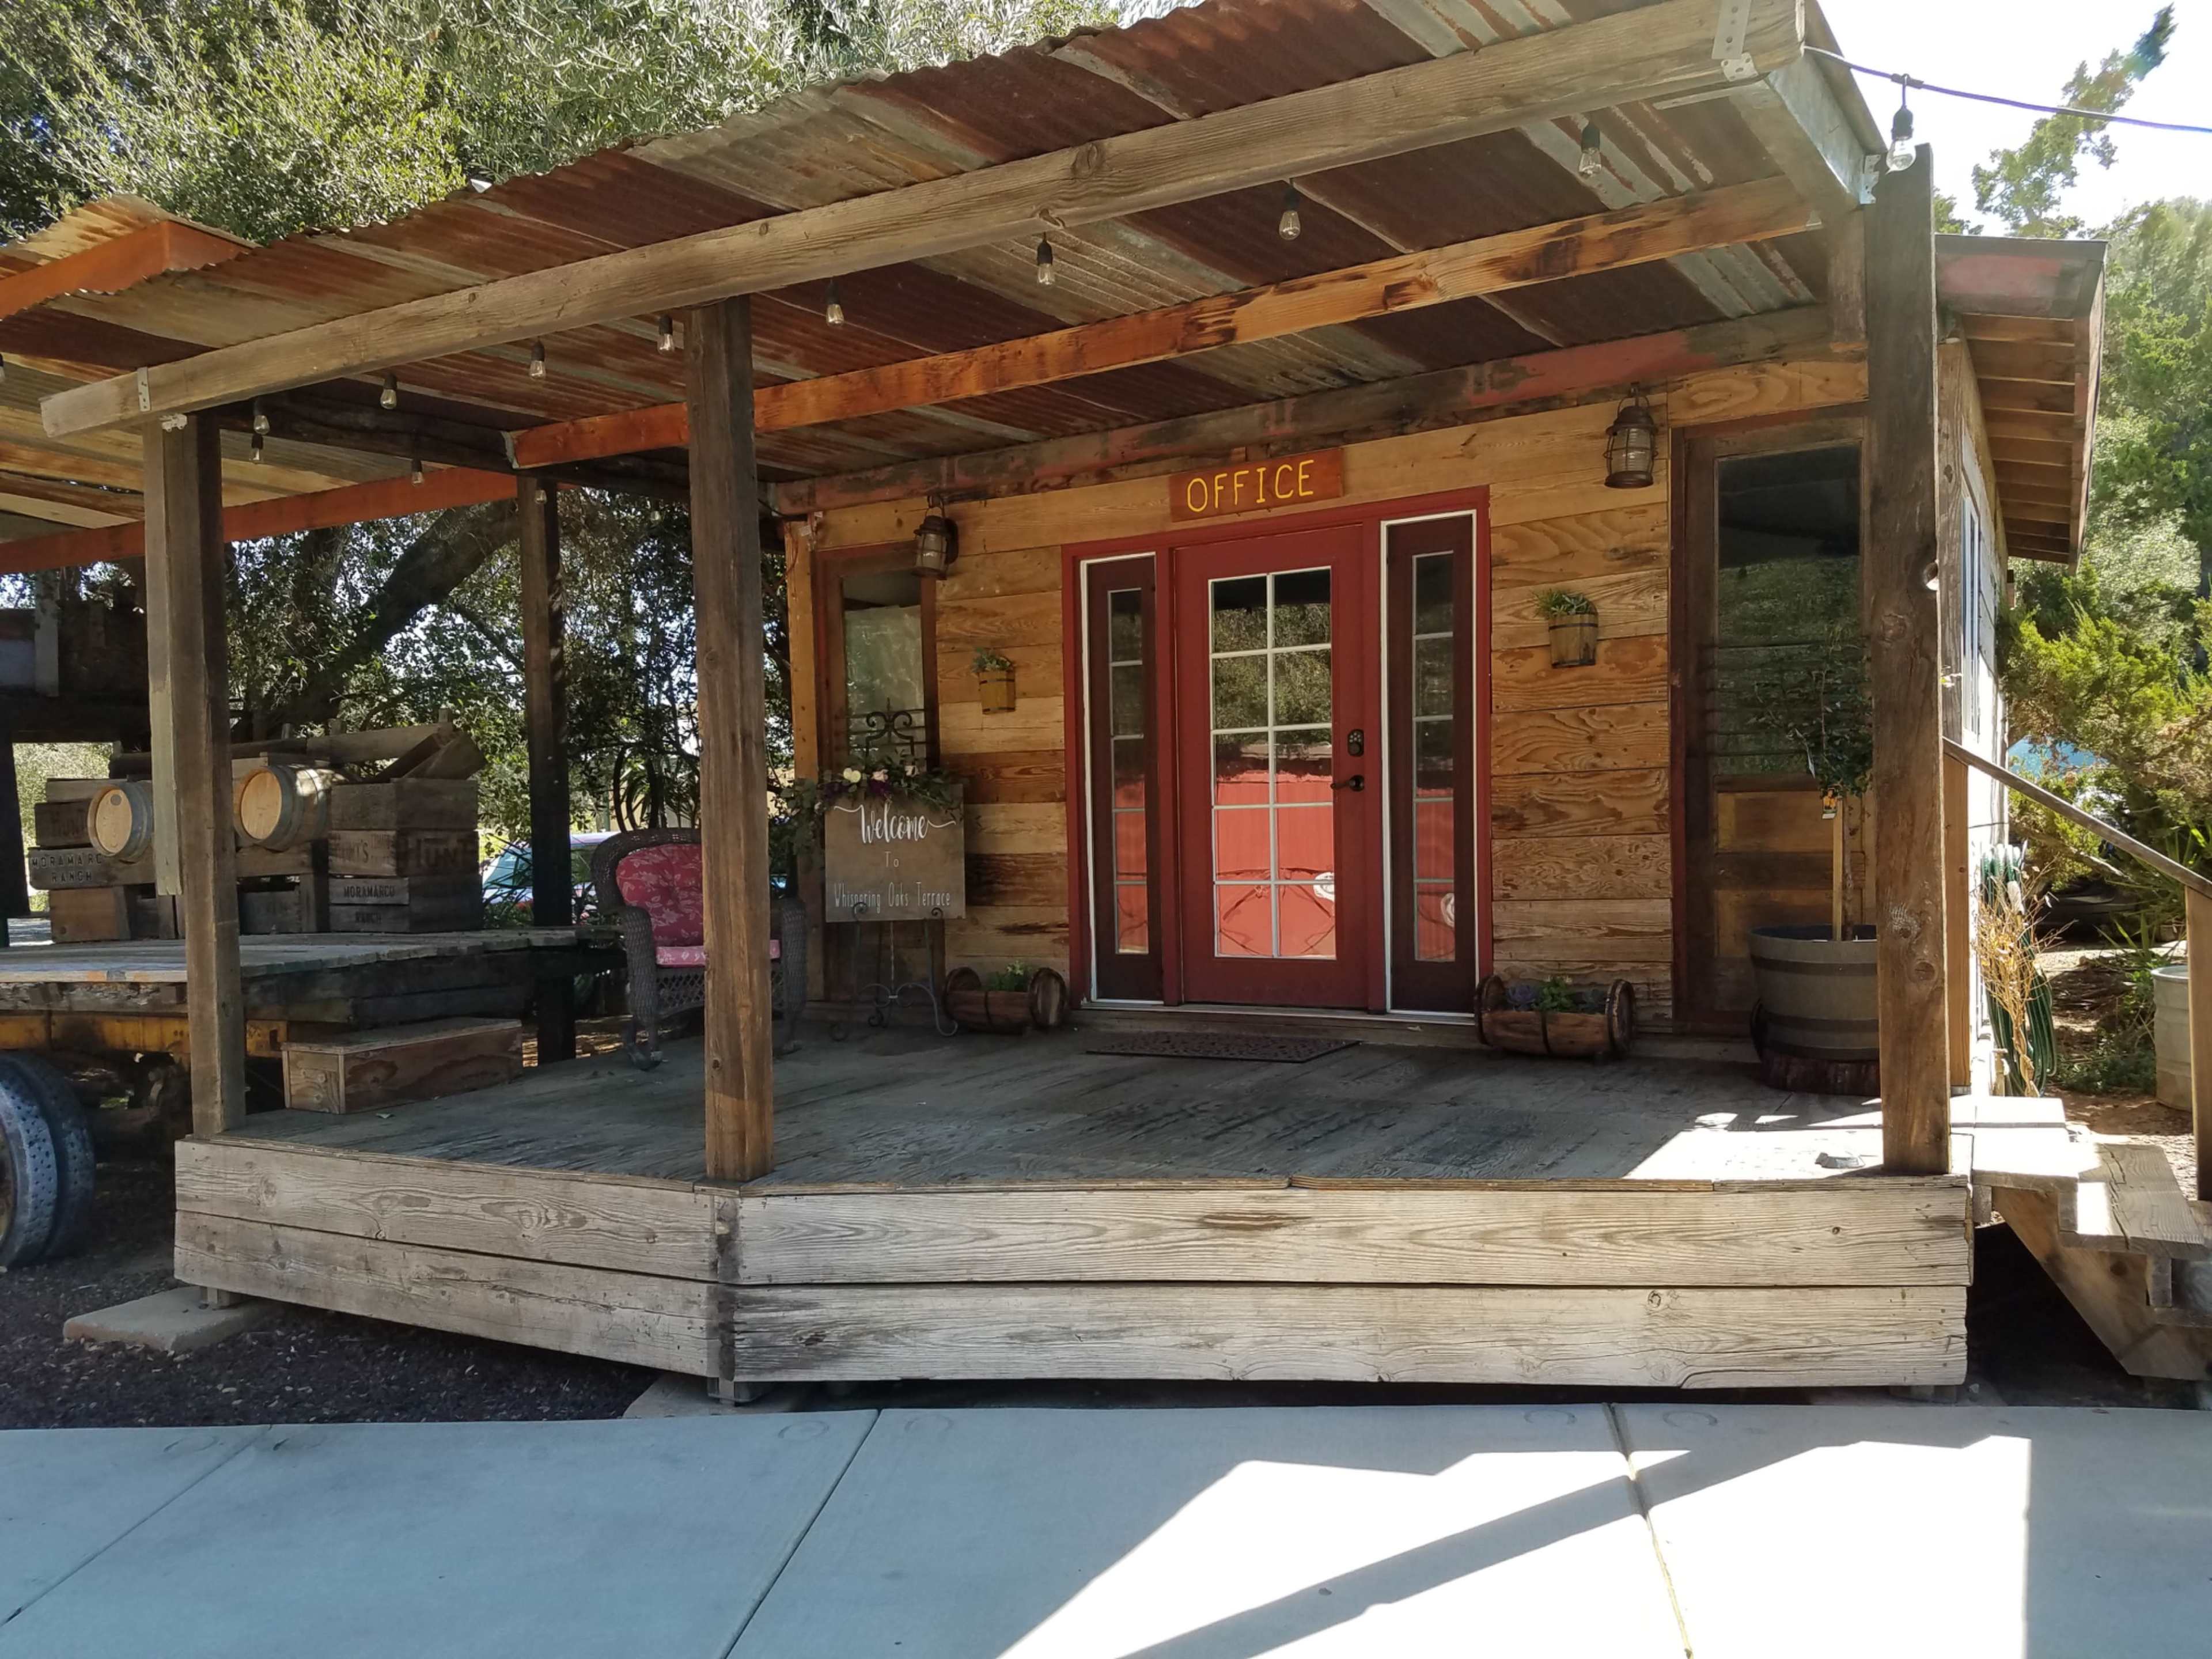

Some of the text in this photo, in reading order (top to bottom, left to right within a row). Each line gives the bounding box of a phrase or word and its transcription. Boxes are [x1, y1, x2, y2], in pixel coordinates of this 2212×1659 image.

[1187, 460, 1315, 512] OFFICE
[834, 802, 956, 844] Welcome
[885, 851, 899, 868] To
[52, 870, 93, 884] RANCH
[344, 884, 395, 898] MORAMARCO
[834, 881, 950, 914] Whispering Oaks Terrace
